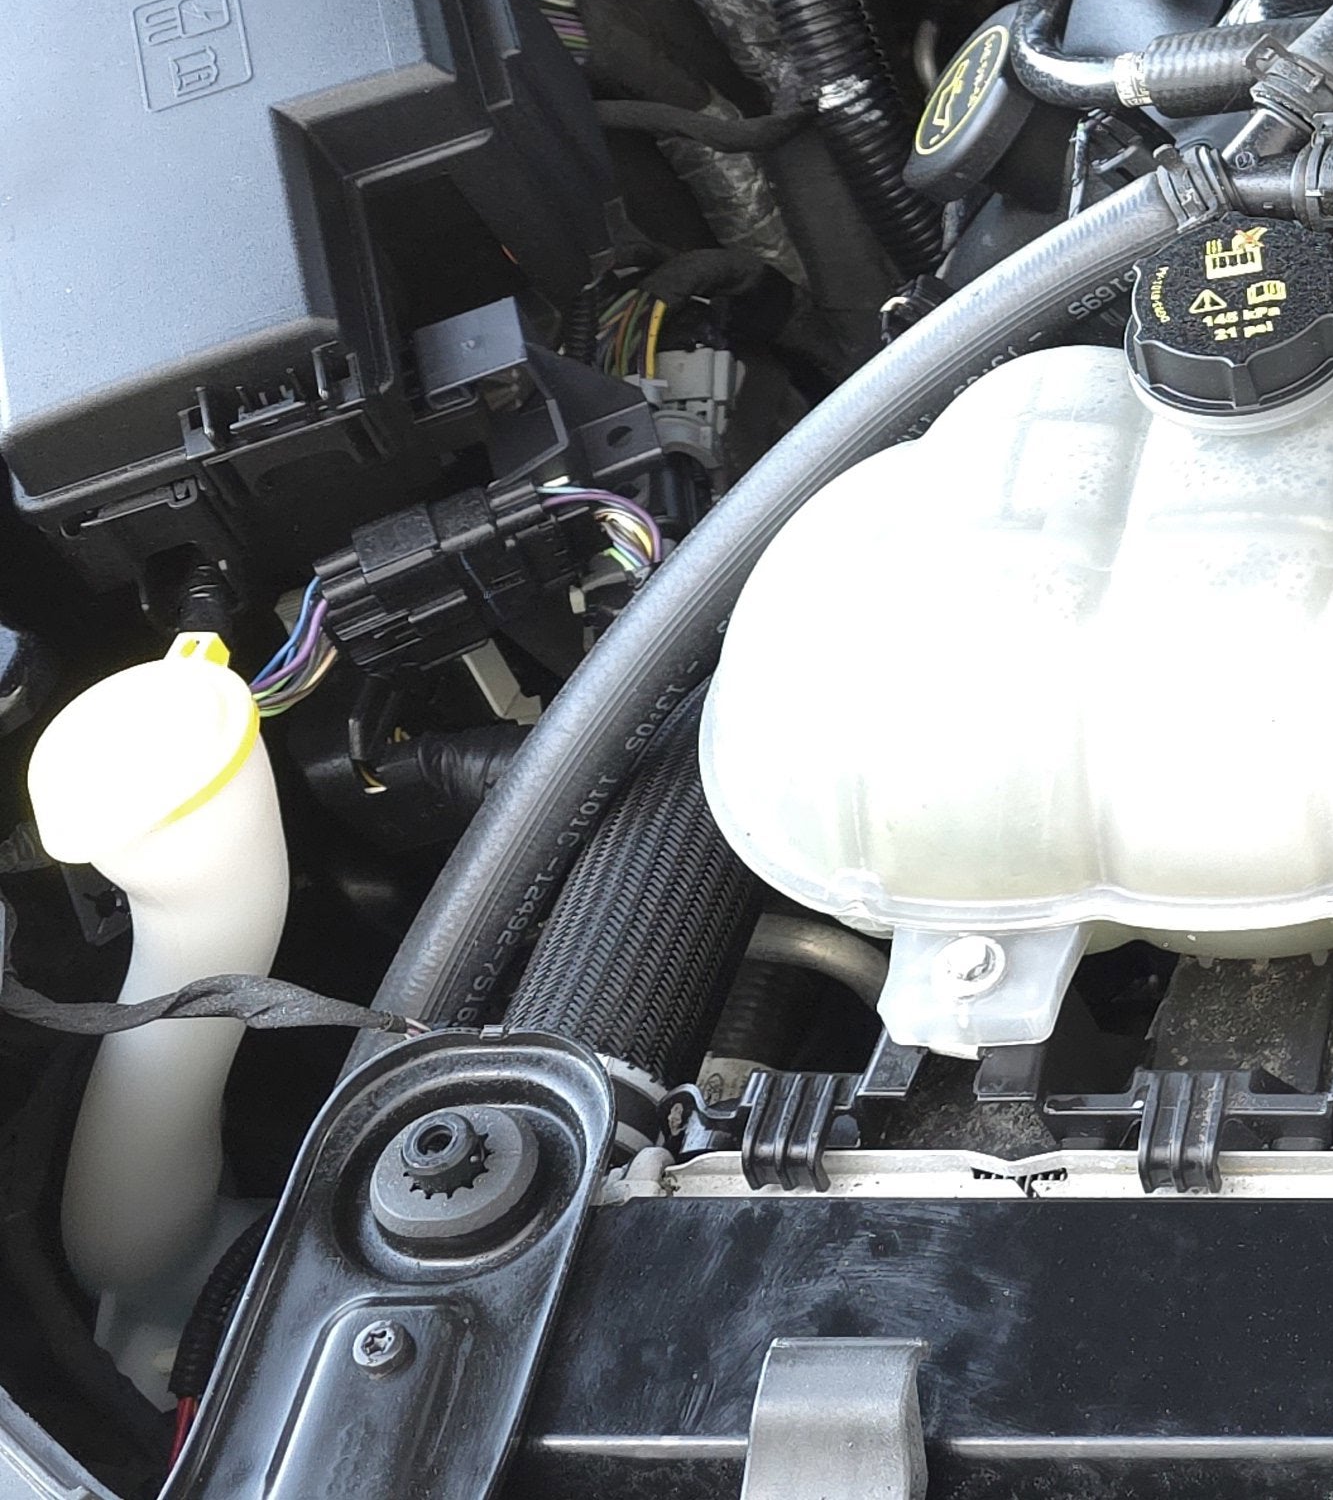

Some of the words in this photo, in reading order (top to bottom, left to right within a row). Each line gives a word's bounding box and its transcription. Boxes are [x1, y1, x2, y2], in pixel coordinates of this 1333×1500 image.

[1202, 310, 1239, 328] 145
[1242, 304, 1281, 321] kPa
[1213, 326, 1238, 341] 21
[1243, 320, 1275, 339] psi
